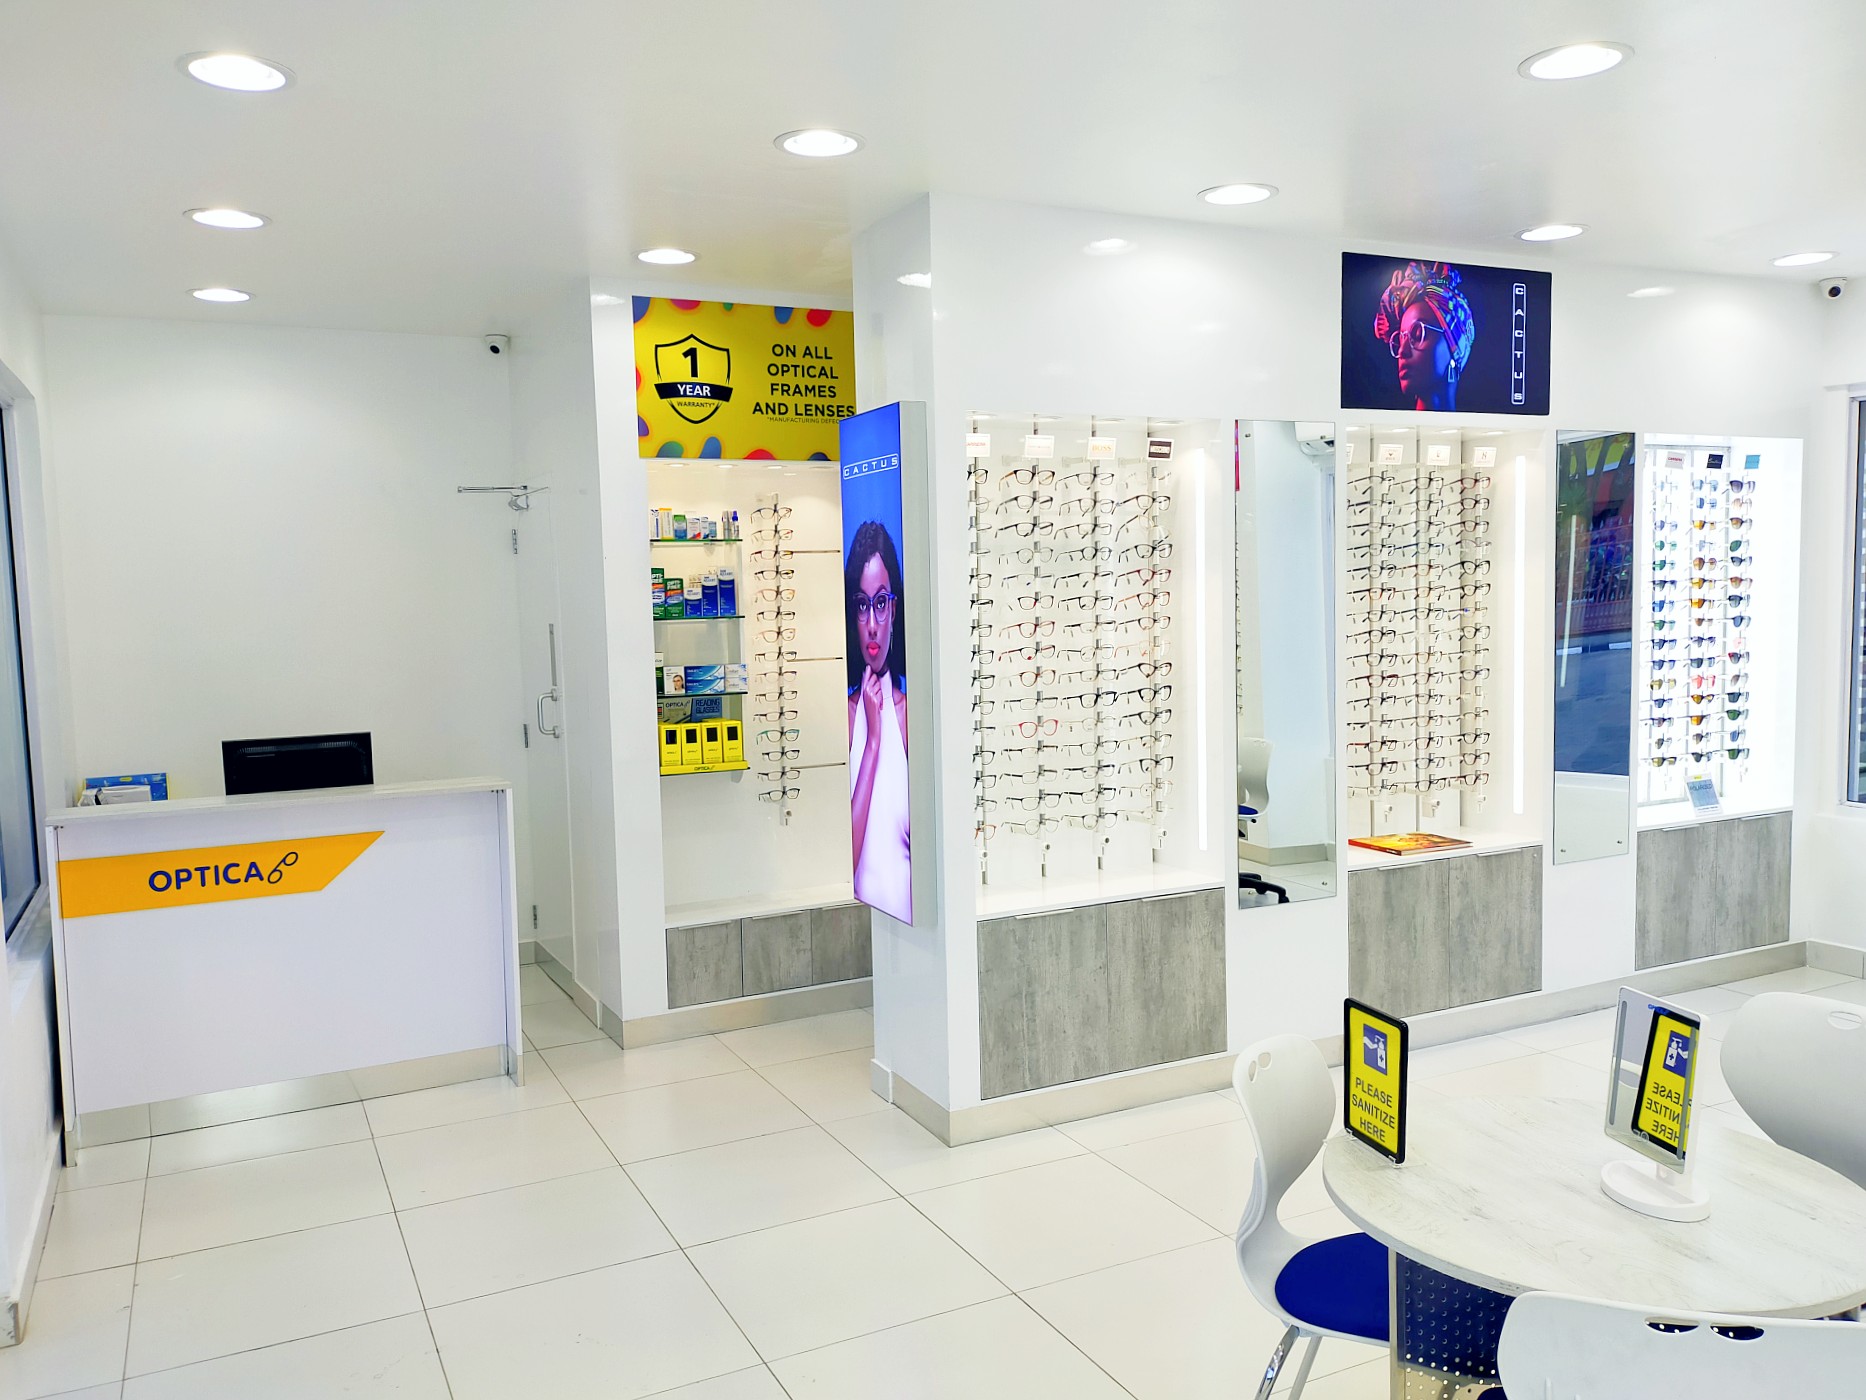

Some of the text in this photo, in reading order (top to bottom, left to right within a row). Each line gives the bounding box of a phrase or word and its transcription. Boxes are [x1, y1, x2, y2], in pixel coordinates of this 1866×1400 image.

[772, 343, 833, 360] ON ALL
[1513, 287, 1525, 401] CACTUS
[682, 347, 699, 378] 1
[767, 363, 839, 379] OPTICAL
[677, 383, 711, 397] YEAR
[770, 382, 837, 399] FRAMES
[752, 402, 855, 418] AND LENSES
[844, 457, 898, 477] CACTUS
[695, 698, 720, 706] READING
[148, 861, 265, 892] OPTICA
[1355, 1076, 1393, 1109] PLEASE
[1351, 1093, 1396, 1130] SANITIZE
[1359, 1119, 1386, 1144] HERE
